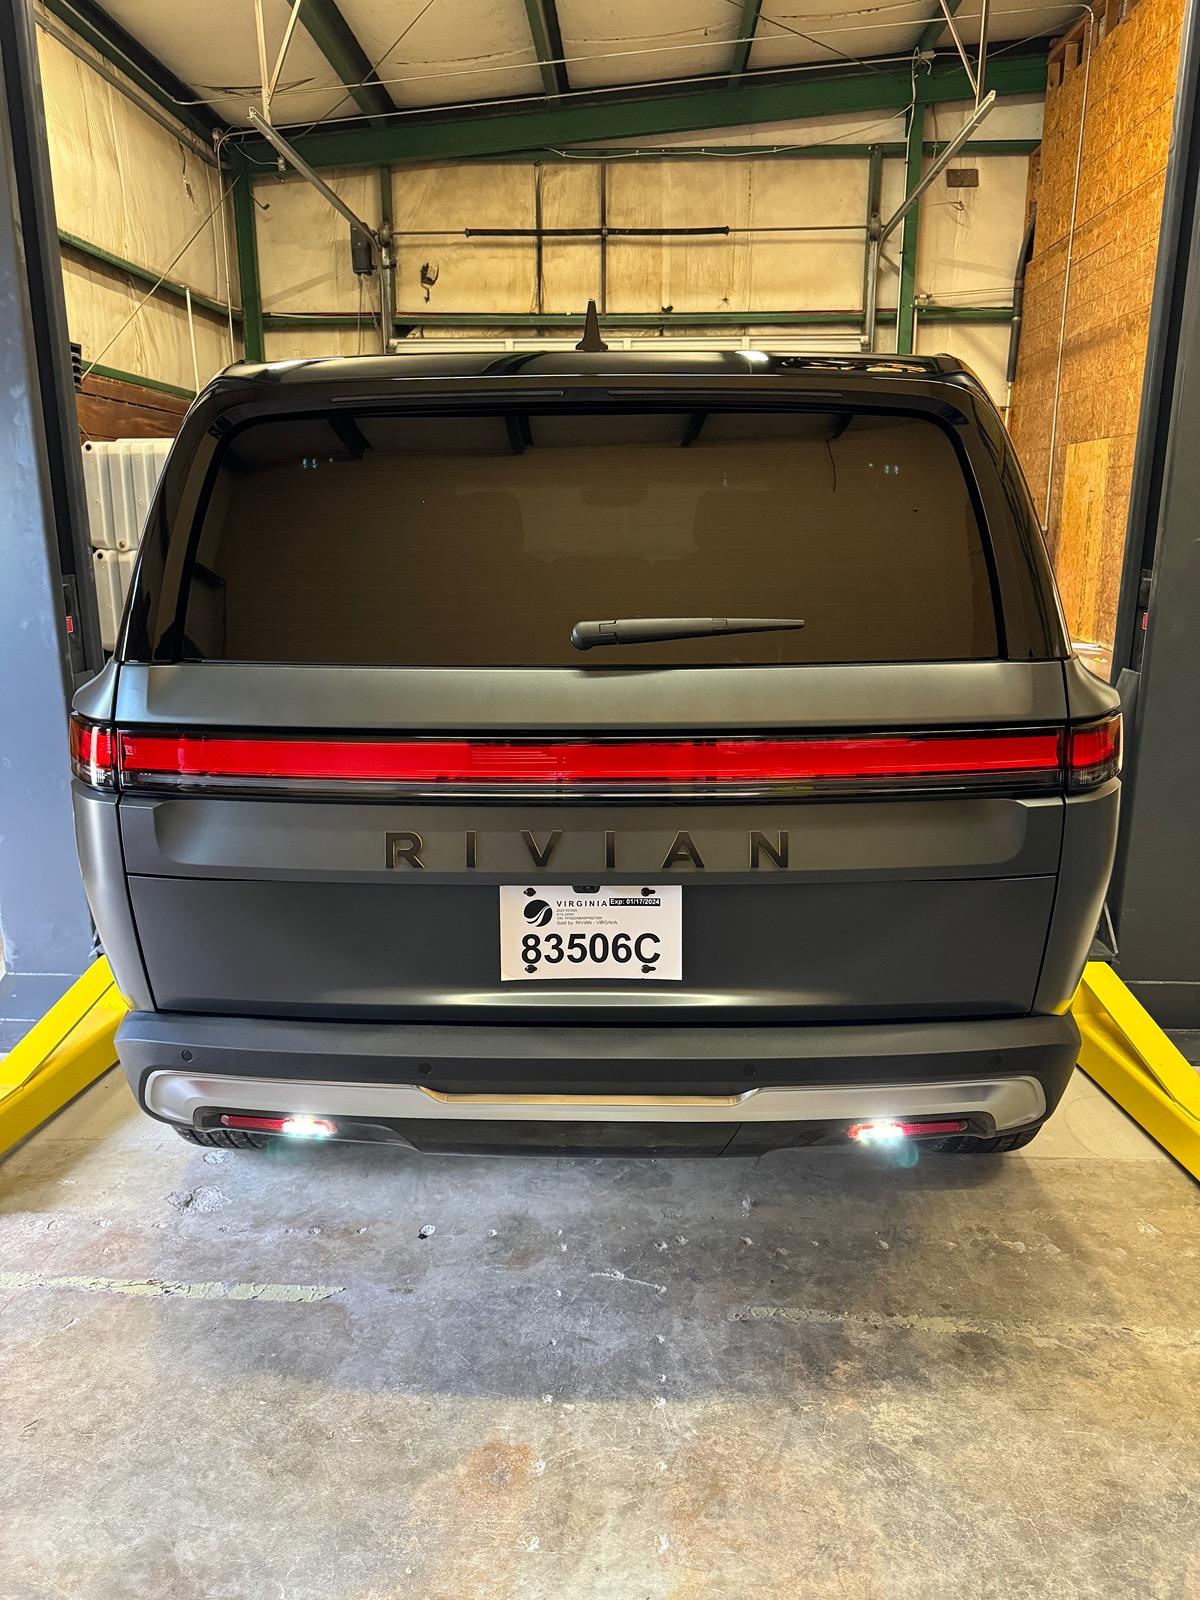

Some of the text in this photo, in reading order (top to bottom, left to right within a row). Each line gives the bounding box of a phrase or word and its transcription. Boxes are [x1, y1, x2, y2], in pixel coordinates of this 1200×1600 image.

[384, 829, 790, 868] RIVIAN
[610, 898, 625, 906] Exp:
[521, 932, 661, 964] 83506C
